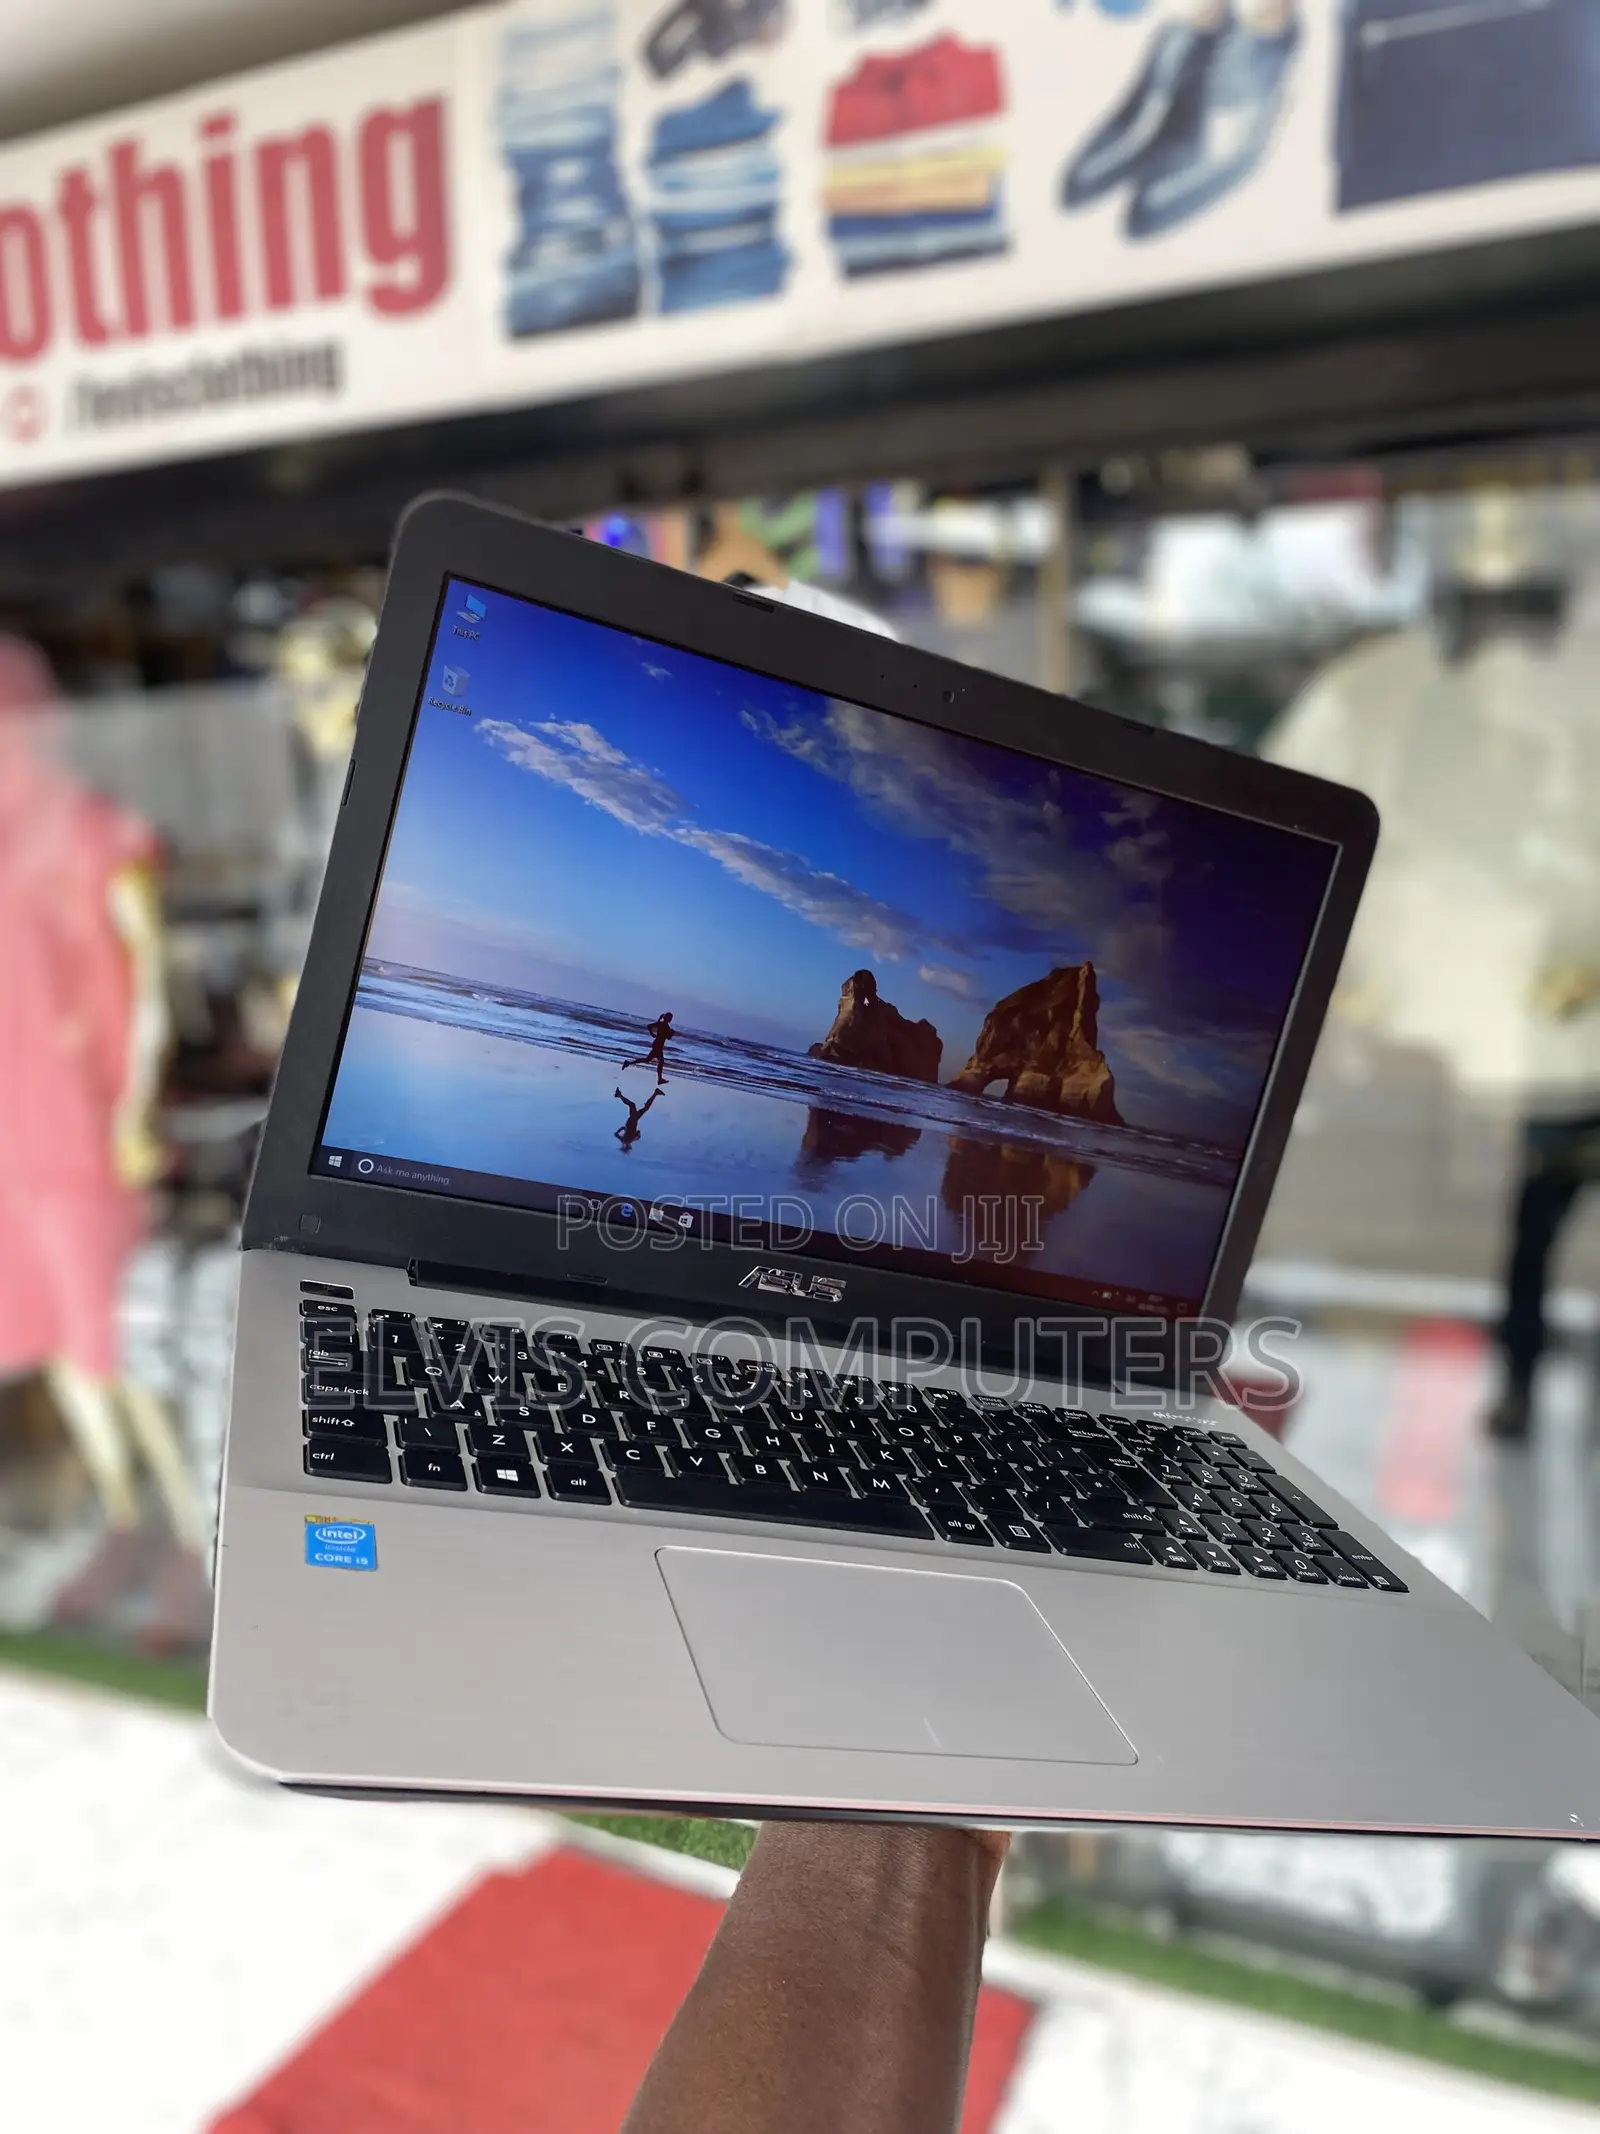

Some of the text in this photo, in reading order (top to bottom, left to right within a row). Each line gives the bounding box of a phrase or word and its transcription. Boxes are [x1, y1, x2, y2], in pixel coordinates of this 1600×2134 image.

[0, 93, 453, 366] othing
[376, 1164, 450, 1186] Ask me anything
[455, 1343, 466, 1352] 2
[309, 1349, 329, 1357] tab
[517, 1351, 528, 1360] 3
[578, 1360, 588, 1368] 4
[425, 1366, 443, 1377] Q
[636, 1367, 646, 1376] 5
[488, 1374, 508, 1384] W
[693, 1375, 704, 1383] 6
[309, 1384, 369, 1396] caps lock
[557, 1383, 568, 1392] E
[747, 1381, 757, 1390] 7
[619, 1390, 630, 1400] R
[802, 1389, 813, 1398] 8
[450, 1400, 465, 1409] A
[677, 1397, 687, 1407] T
[855, 1396, 864, 1405] 9
[519, 1406, 530, 1416] S
[734, 1405, 745, 1414] Y
[311, 1416, 340, 1425] shift
[582, 1413, 596, 1424] D
[790, 1411, 803, 1421] U
[646, 1421, 656, 1431] F
[704, 1428, 721, 1438] G
[492, 1434, 506, 1445] Z
[765, 1435, 780, 1446] H
[953, 1435, 963, 1444] P
[560, 1442, 574, 1453] X
[312, 1452, 335, 1461] ctrl
[626, 1449, 641, 1460] C
[880, 1450, 894, 1460] K
[689, 1455, 703, 1466] V
[937, 1458, 948, 1468] L
[428, 1463, 441, 1472] fn
[755, 1464, 767, 1475] B
[812, 1470, 829, 1482] N
[570, 1478, 587, 1487] alt
[872, 1478, 891, 1490] M
[1231, 1497, 1243, 1507] 5
[1271, 1503, 1281, 1512] 6
[1122, 1512, 1142, 1520] shift
[947, 1519, 976, 1531] alt gr
[1221, 1522, 1232, 1532] 1
[322, 1527, 358, 1540] intel
[1261, 1527, 1275, 1538] 2
[1301, 1532, 1314, 1543] 3
[1123, 1541, 1140, 1549] ctrl
[314, 1552, 352, 1564] CORE
